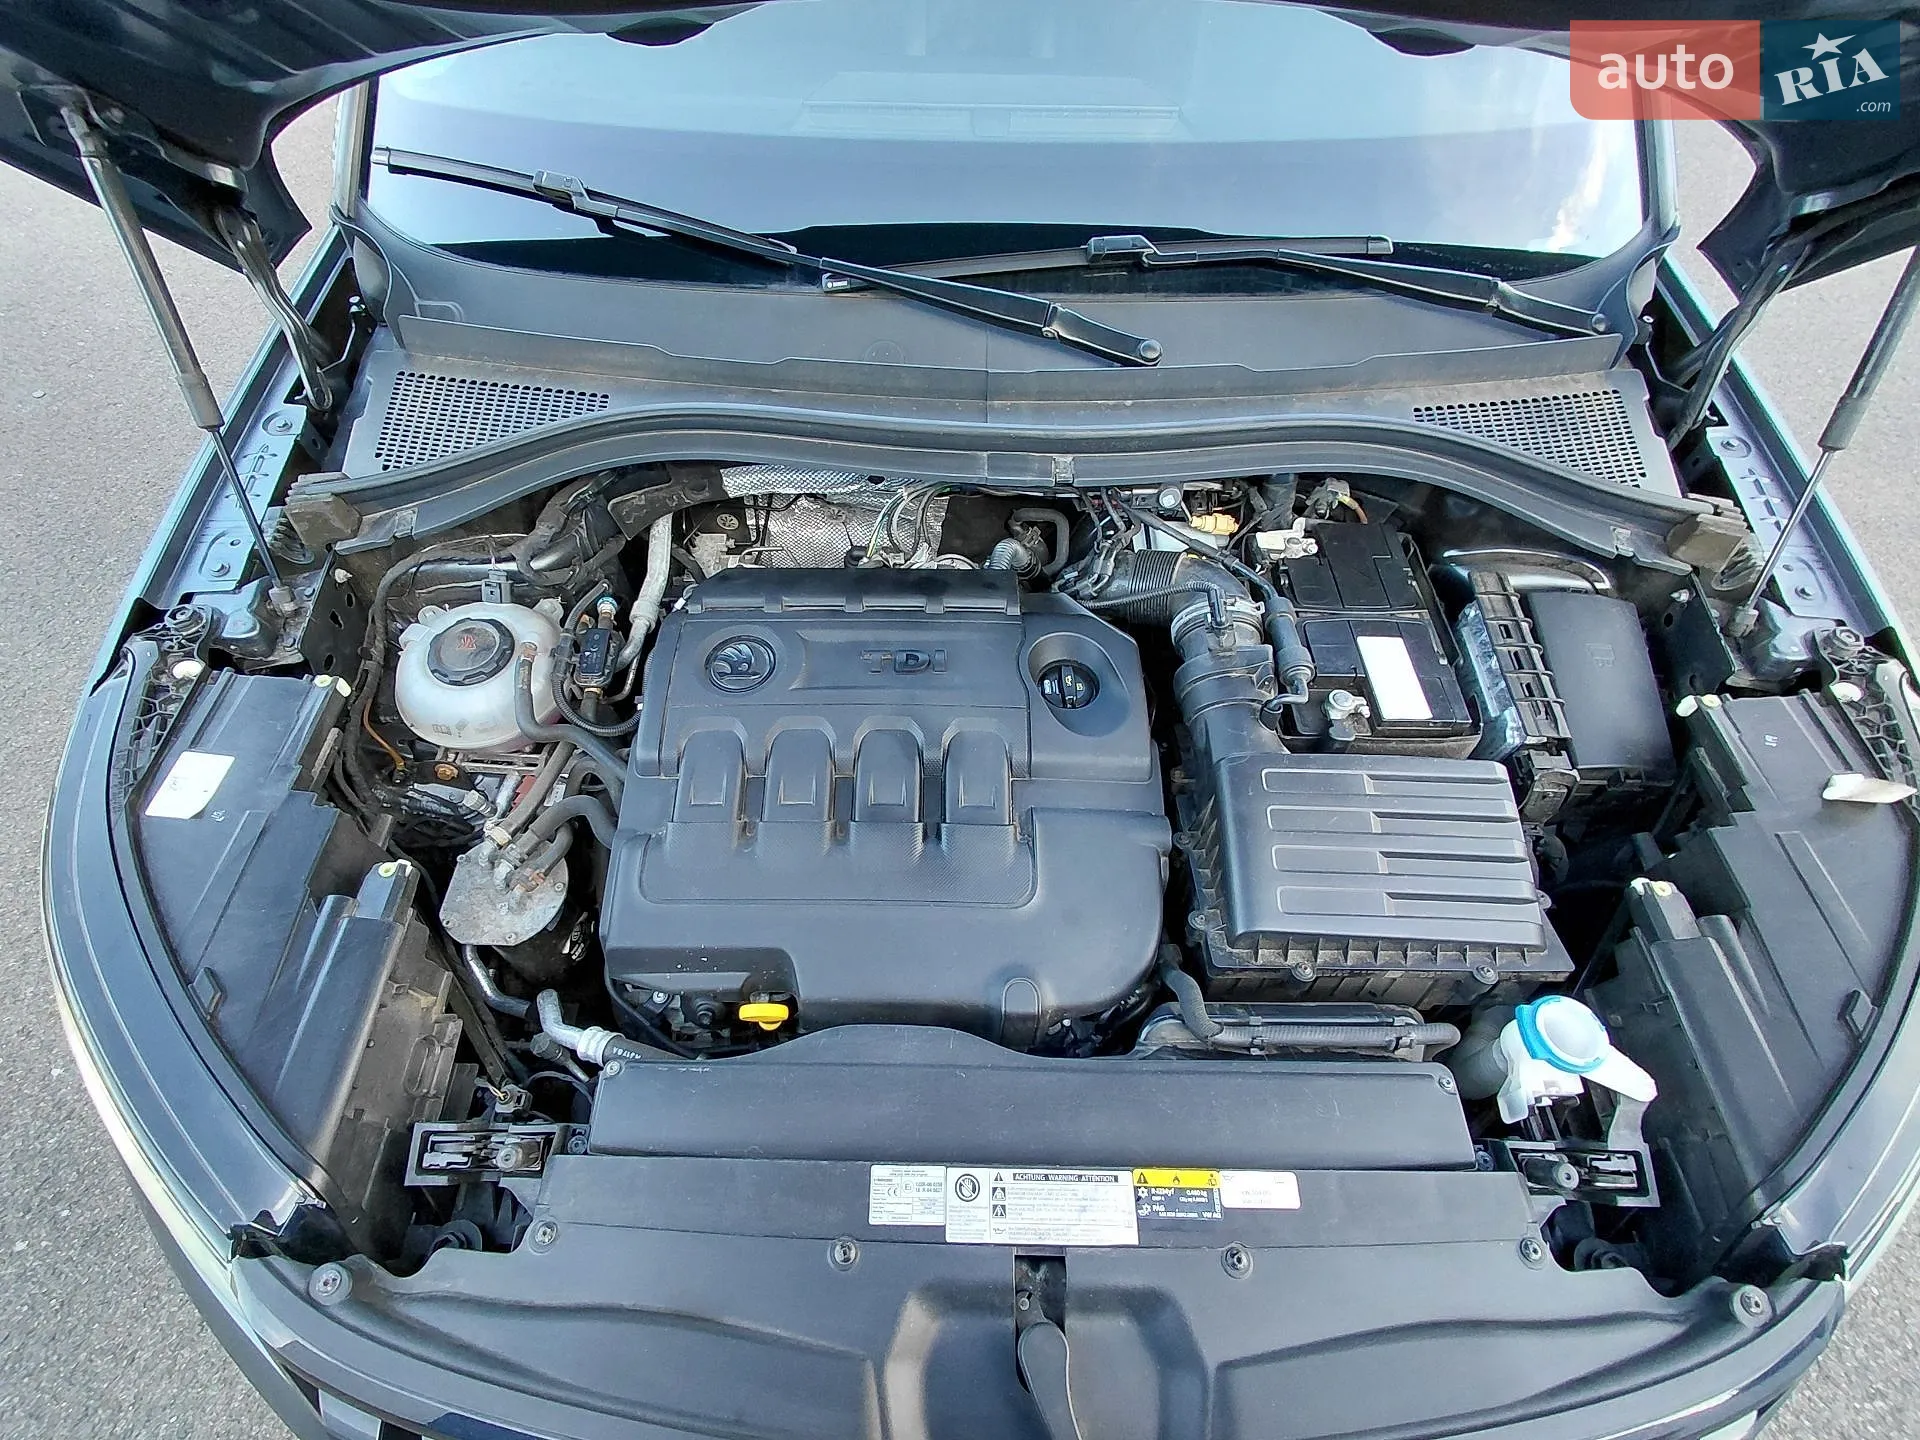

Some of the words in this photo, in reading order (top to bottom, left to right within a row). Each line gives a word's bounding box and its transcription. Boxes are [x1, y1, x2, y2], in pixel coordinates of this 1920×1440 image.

[860, 649, 947, 675] TDI
[1015, 1173, 1046, 1181] ACHTUNG
[1048, 1174, 1079, 1182] WARNING
[1081, 1174, 1115, 1183] ATTENTION
